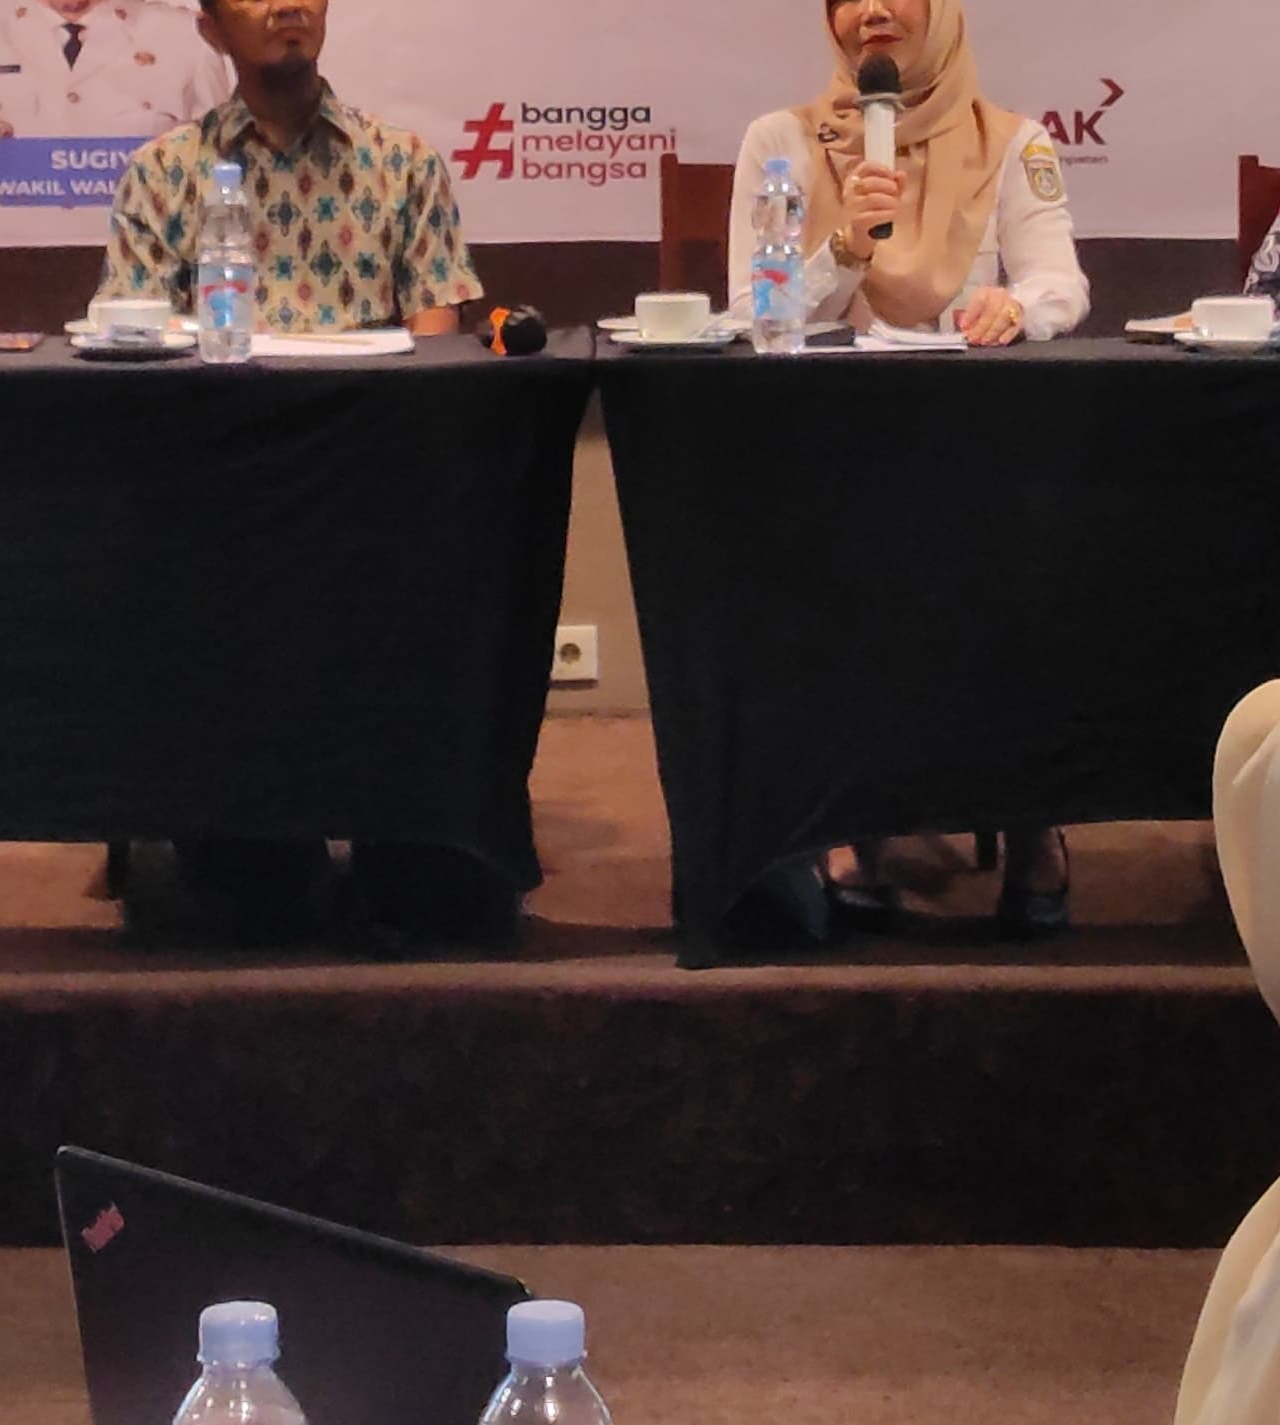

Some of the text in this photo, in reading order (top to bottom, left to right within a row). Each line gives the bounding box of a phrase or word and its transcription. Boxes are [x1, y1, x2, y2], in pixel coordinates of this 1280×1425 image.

[521, 102, 651, 131] bangga
[522, 128, 676, 158] melayani
[522, 157, 647, 187] bangsa
